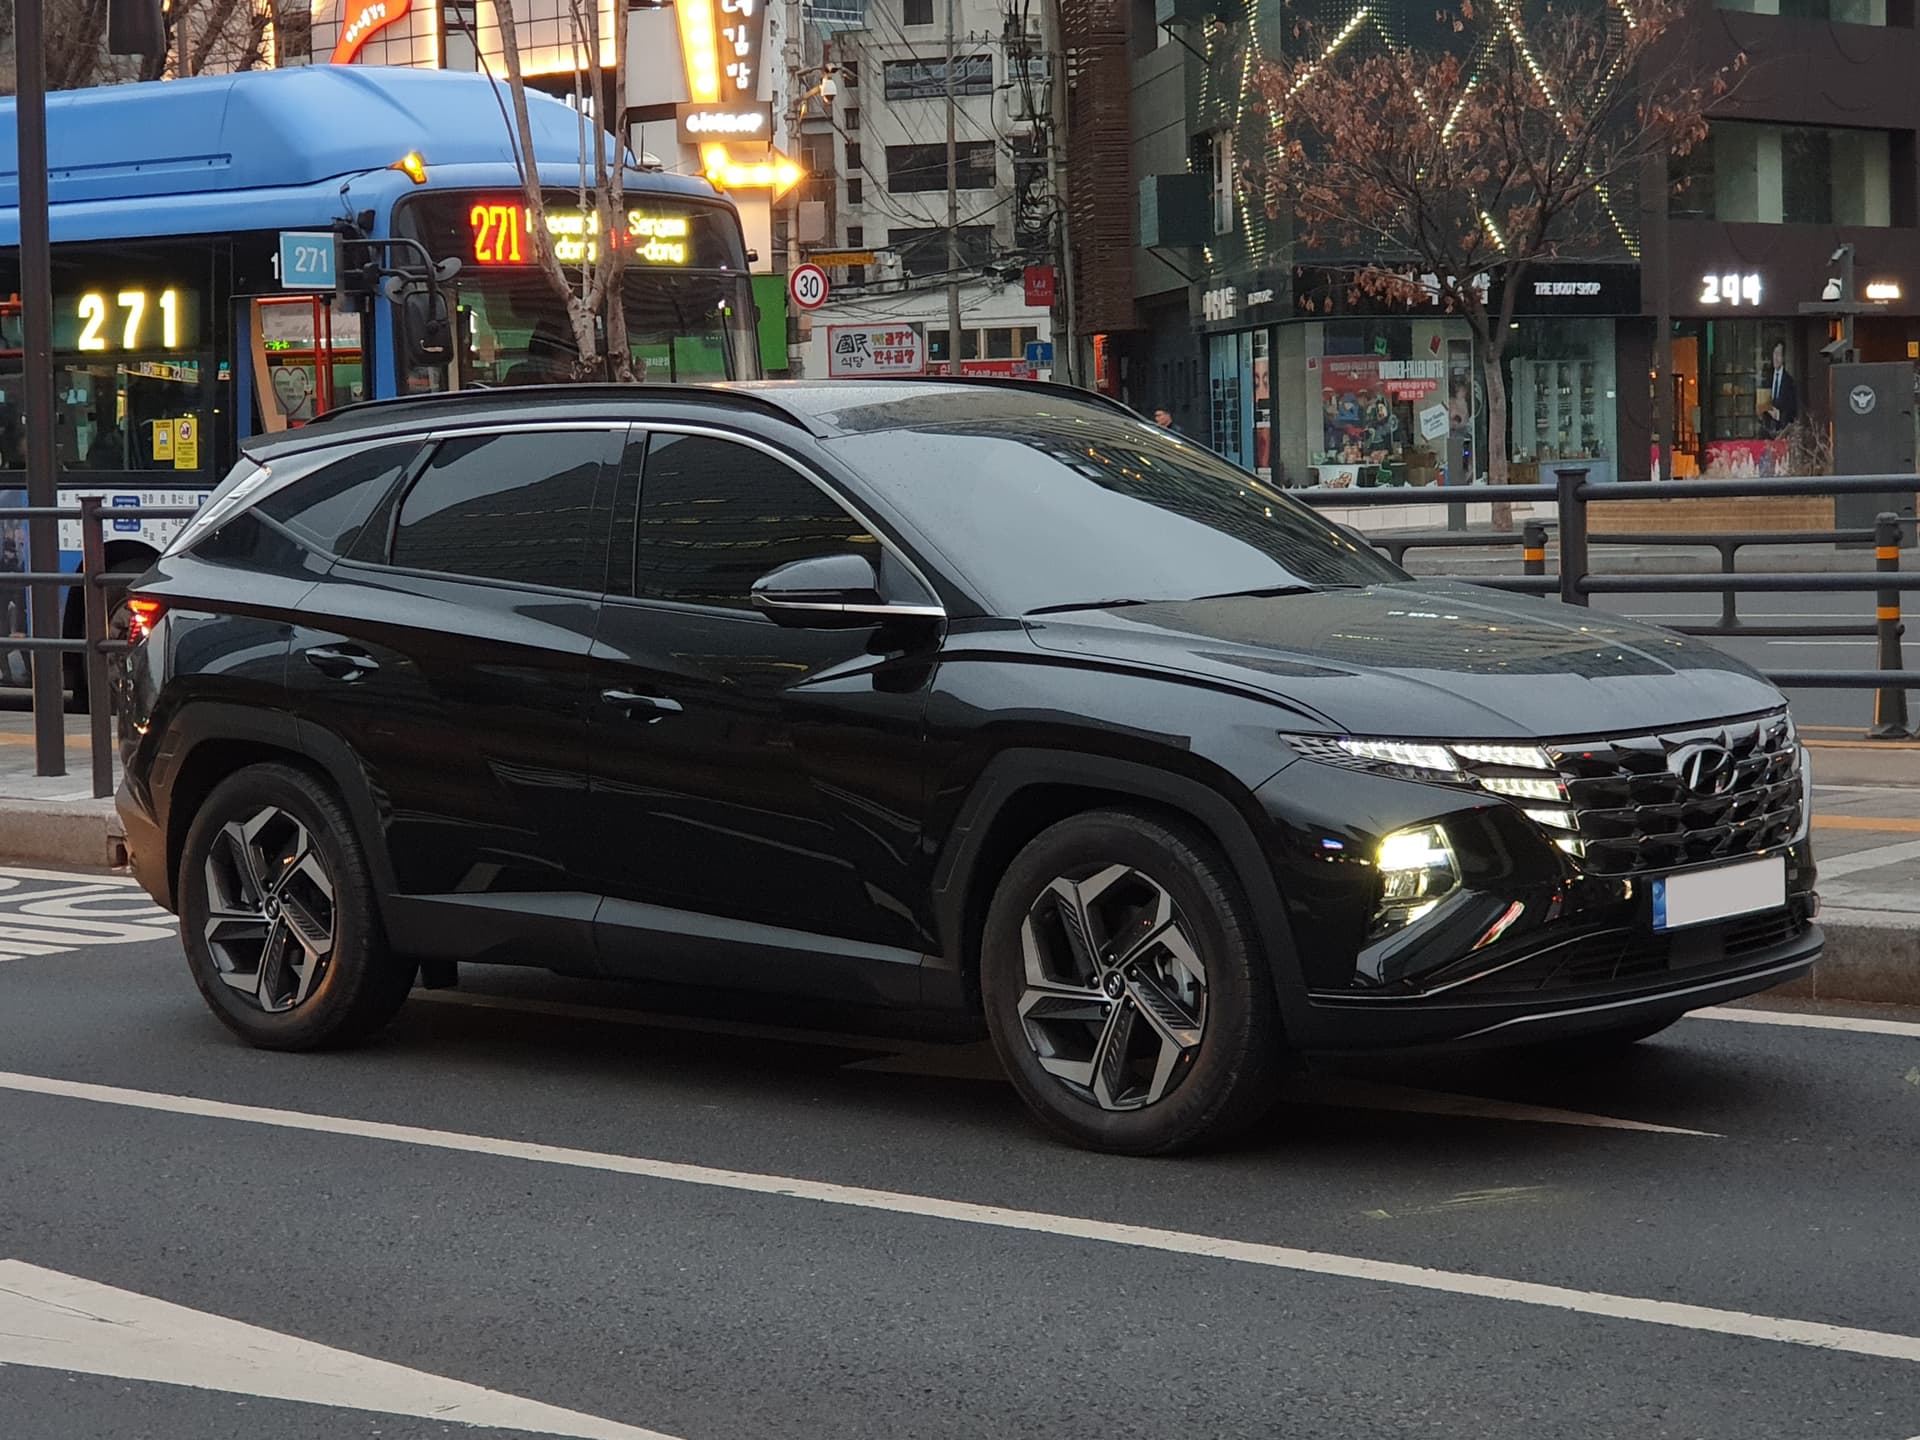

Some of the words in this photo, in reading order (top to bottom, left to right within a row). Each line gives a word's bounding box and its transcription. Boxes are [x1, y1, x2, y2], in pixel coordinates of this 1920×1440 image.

[470, 205, 520, 261] 271
[295, 246, 328, 273] 271
[800, 275, 819, 298] 30
[1533, 281, 1553, 296] THE
[841, 356, 864, 369] 식당
